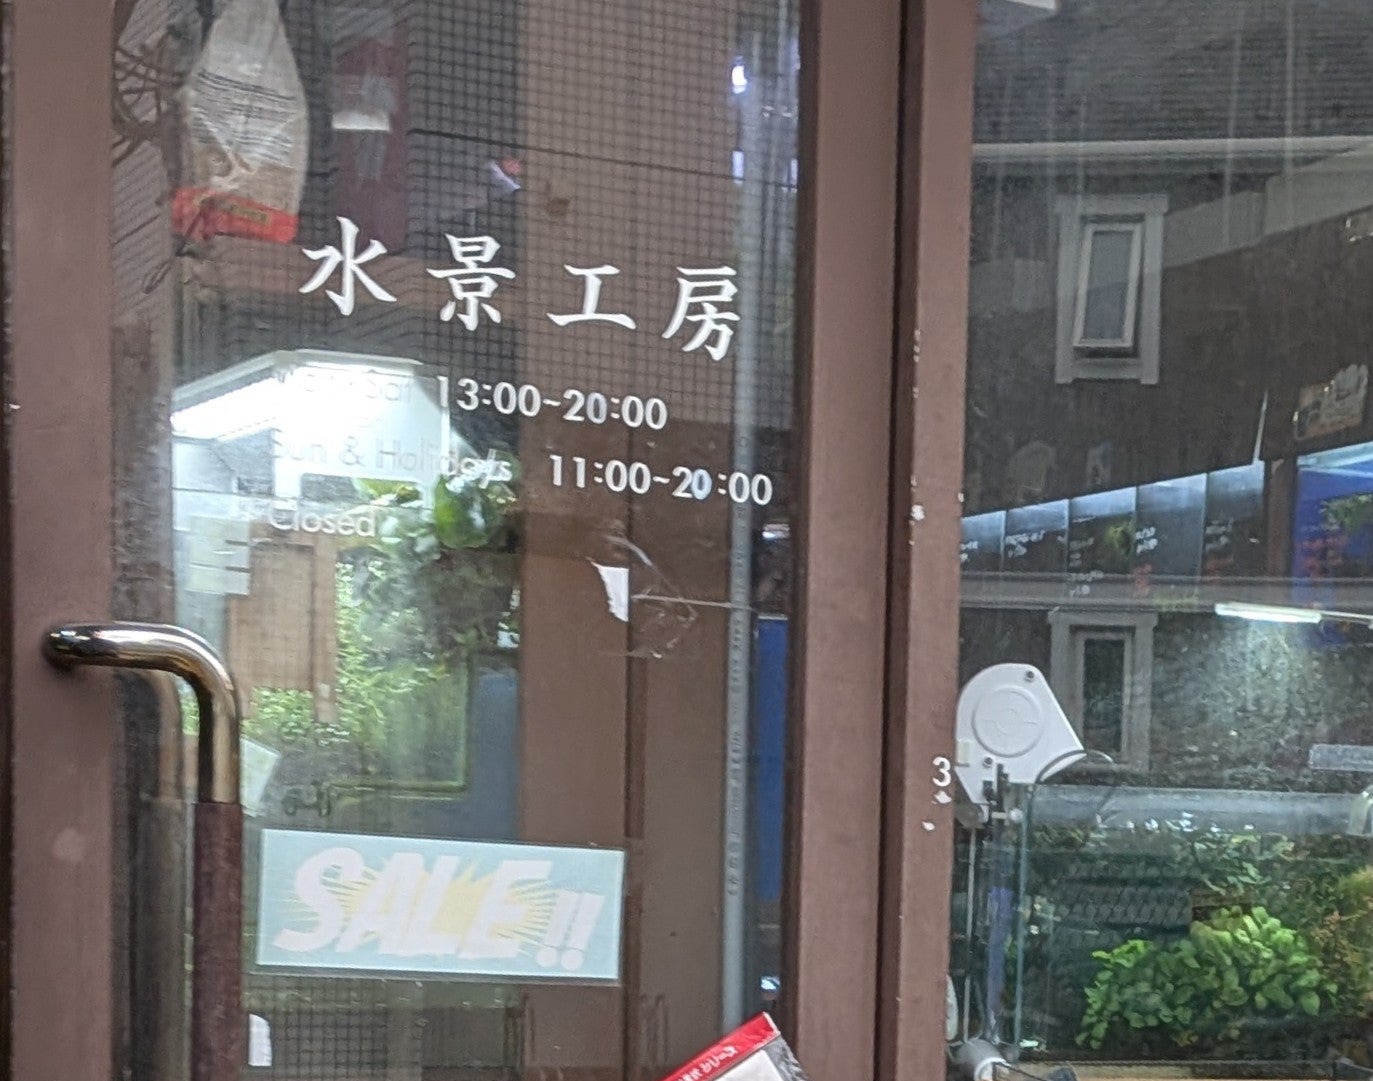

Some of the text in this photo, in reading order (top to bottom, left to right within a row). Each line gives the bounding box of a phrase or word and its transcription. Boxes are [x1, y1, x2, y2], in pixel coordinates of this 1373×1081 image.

[300, 216, 741, 361] 水景工房
[269, 500, 377, 538] Closed
[932, 756, 951, 787] 3
[271, 847, 605, 971] SALE!!
